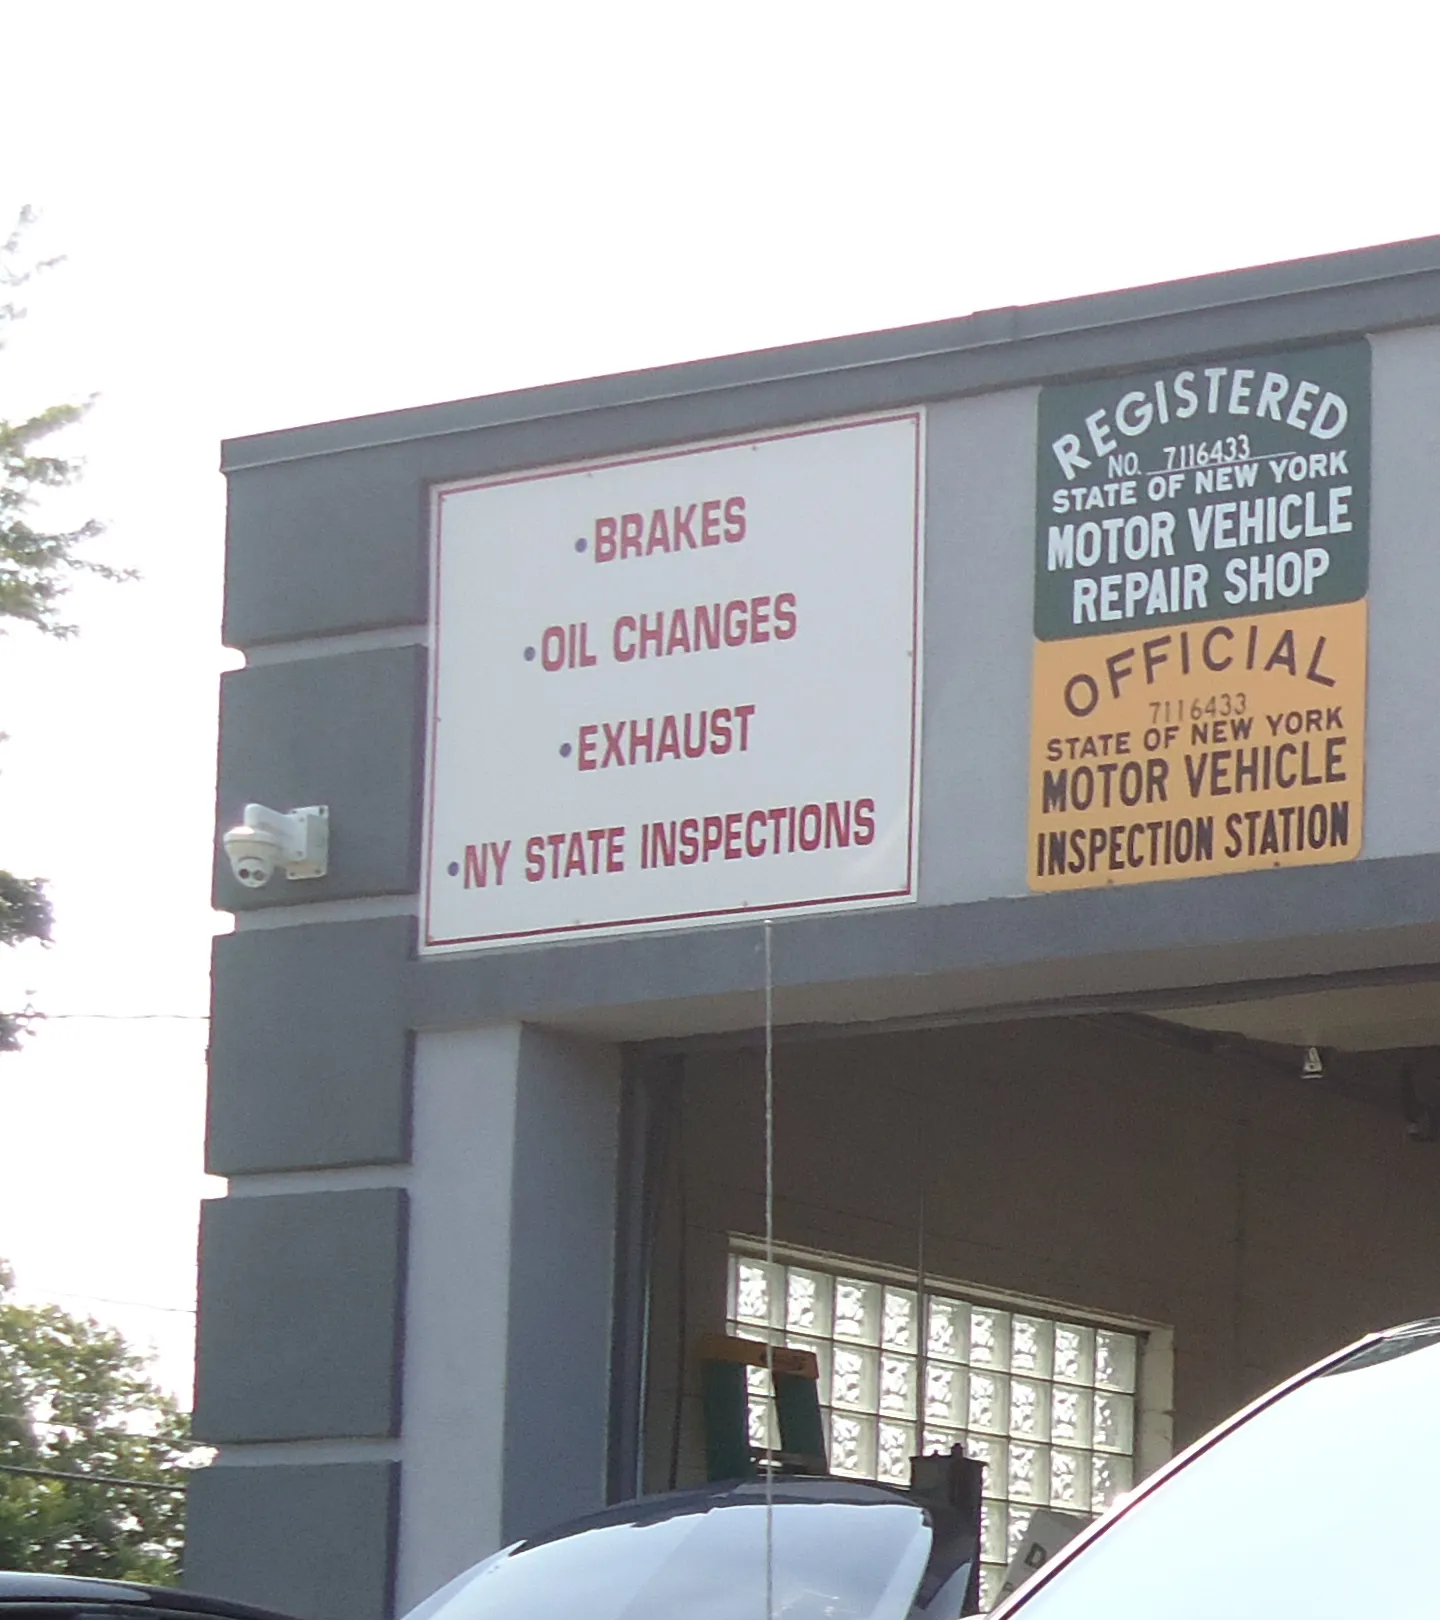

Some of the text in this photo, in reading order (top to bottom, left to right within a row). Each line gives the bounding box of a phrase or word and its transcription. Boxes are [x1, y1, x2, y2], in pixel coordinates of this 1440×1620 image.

[1052, 367, 1348, 480] REGISTERED
[1108, 435, 1250, 478] NO. 7116433
[1052, 450, 1348, 514] STATE OF NEW YORK
[595, 497, 746, 562] BRAKES
[1048, 486, 1353, 572] MOTOR VEHICLE
[1074, 548, 1330, 624] REPAIR SHOP
[542, 592, 797, 672] OIL CHANGES
[1064, 625, 1336, 717] OFFICIAL
[1149, 693, 1248, 725] 7116433
[578, 704, 755, 771] EXHAUST
[1047, 707, 1343, 762] STATE OF NEW YORK
[1042, 737, 1347, 814] MOTOR VEHICLE
[463, 798, 875, 889] NY STATE INSPECTIONS
[1037, 801, 1349, 877] INSPECTION STATION
